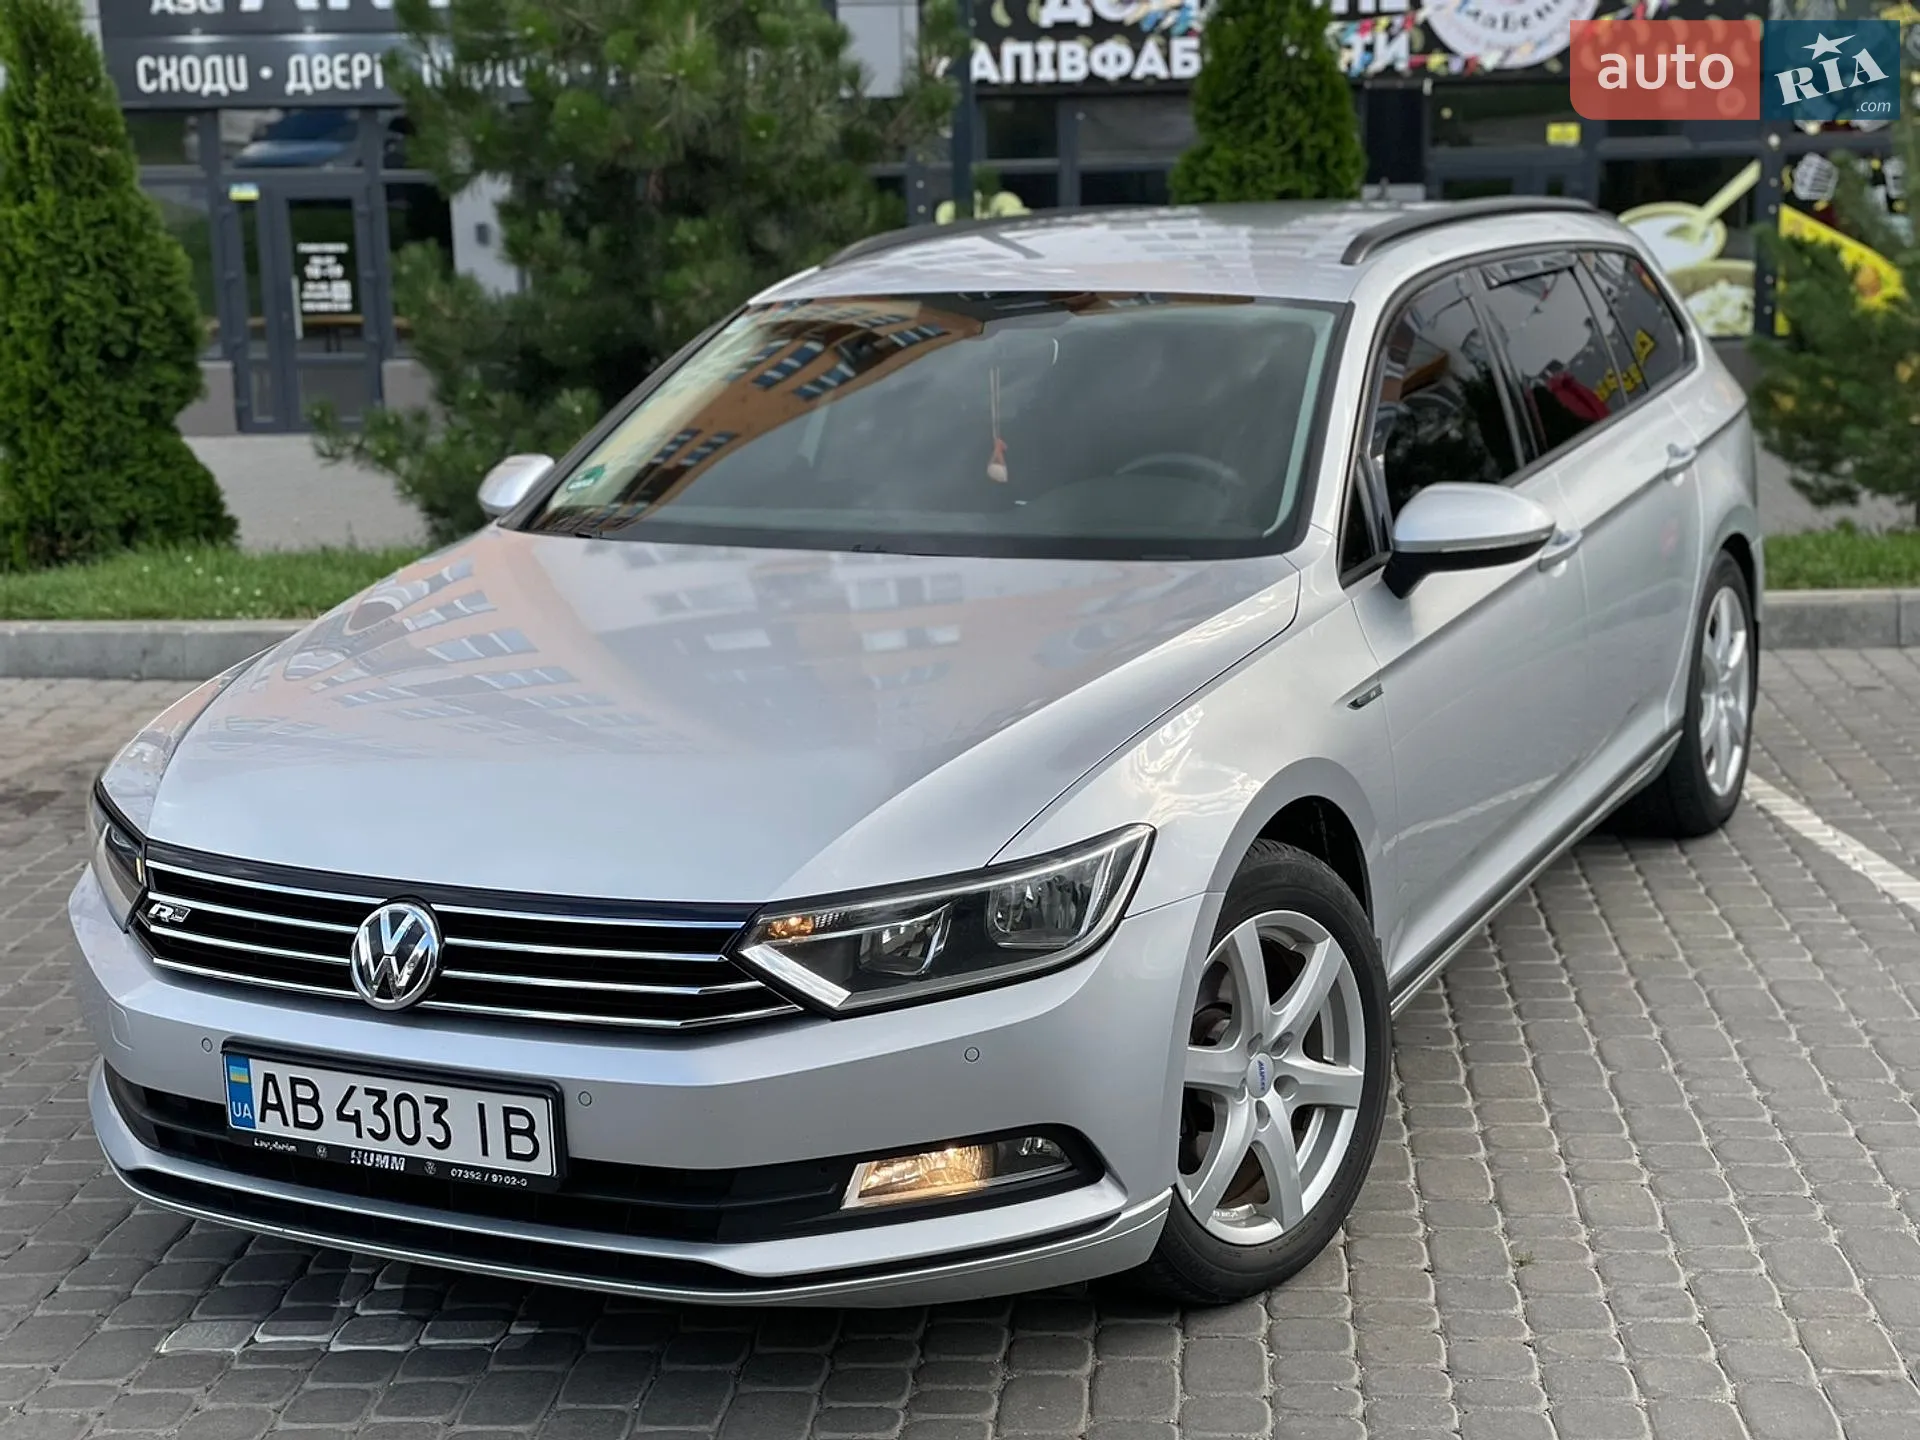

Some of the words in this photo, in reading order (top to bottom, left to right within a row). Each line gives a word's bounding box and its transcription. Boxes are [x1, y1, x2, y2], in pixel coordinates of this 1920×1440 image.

[232, 1101, 253, 1120] UA
[258, 1072, 324, 1131] AB
[336, 1085, 452, 1151] 4303
[478, 1102, 540, 1162] IB
